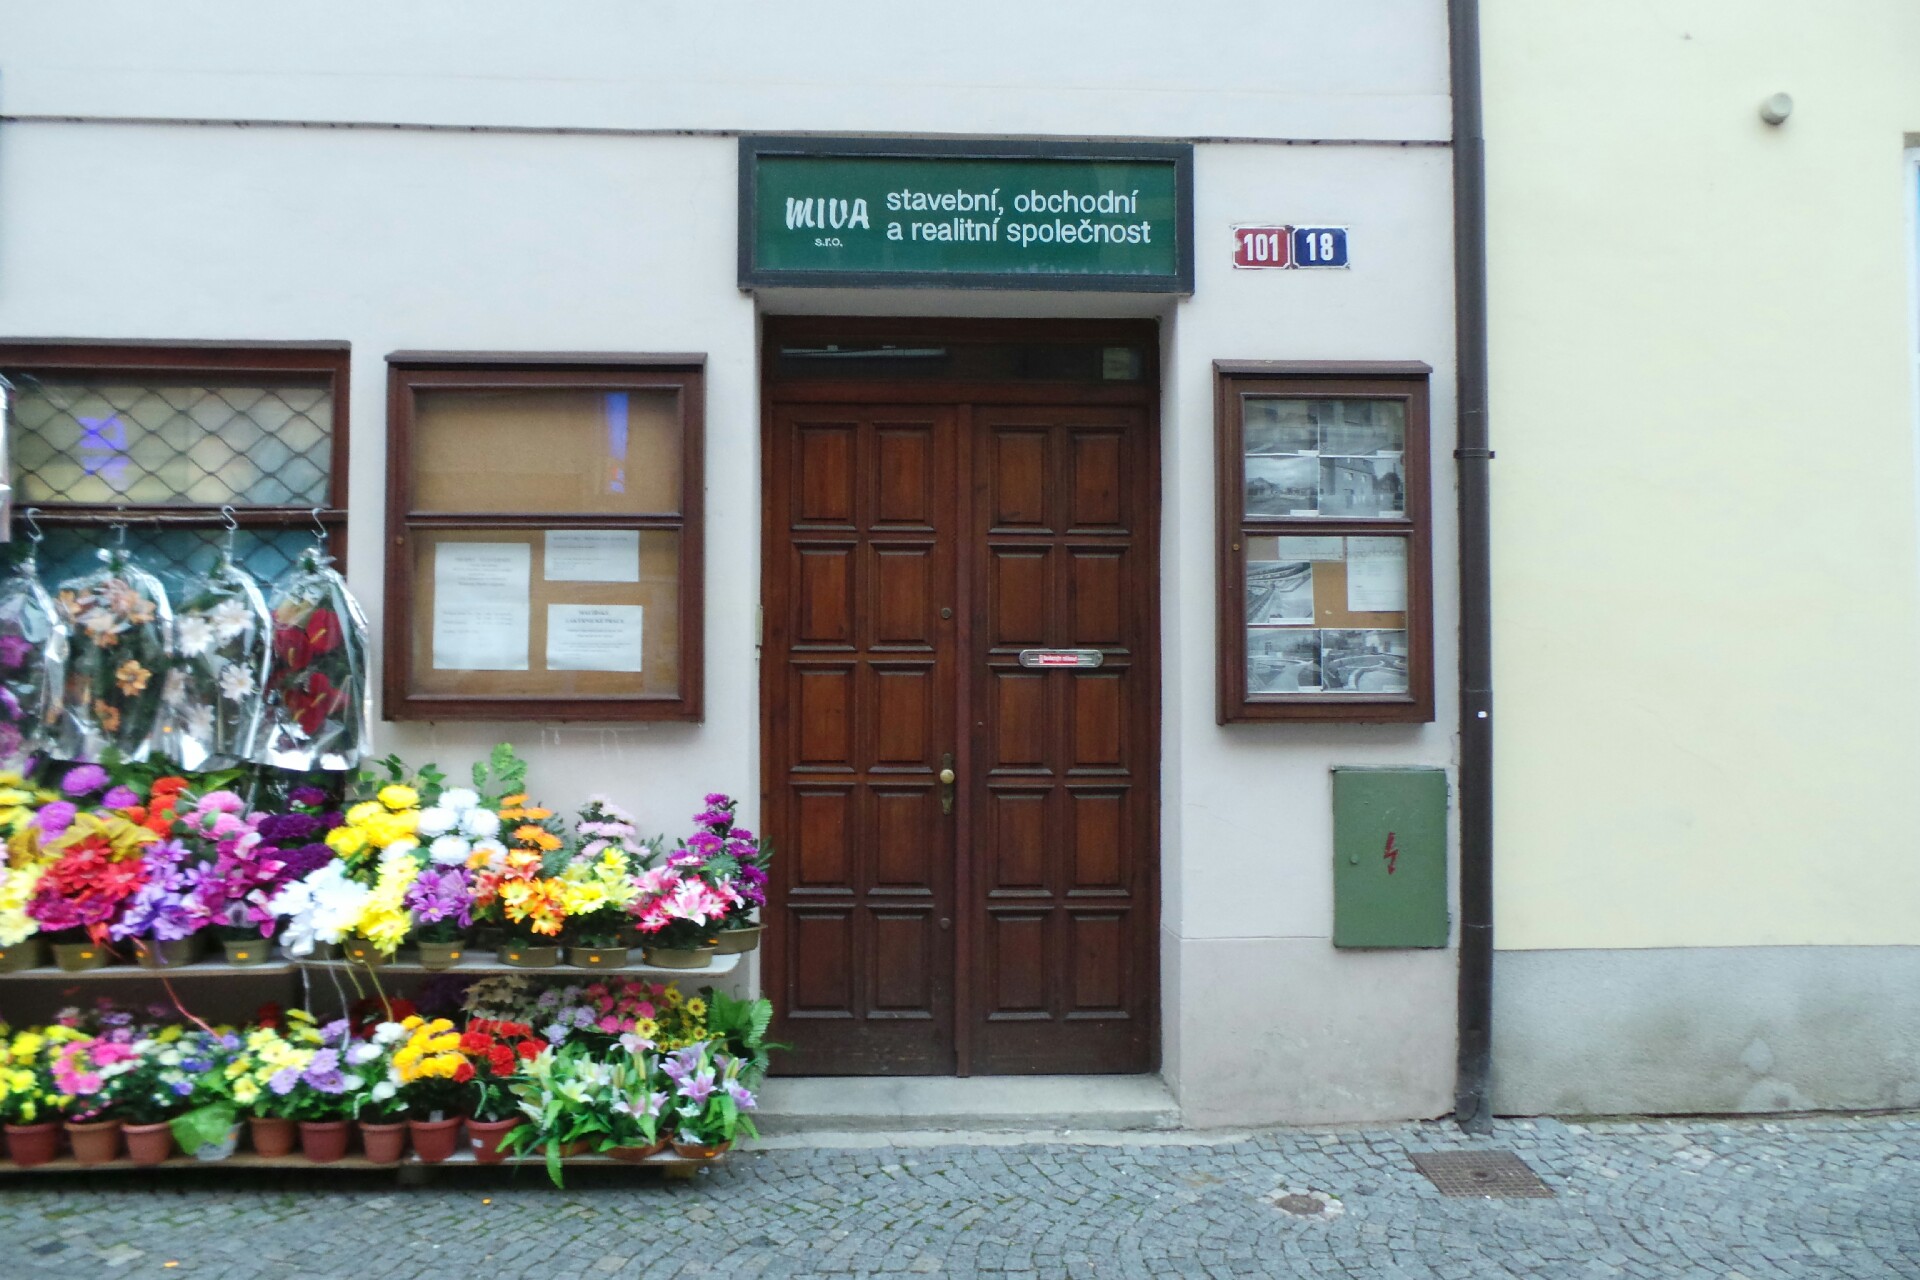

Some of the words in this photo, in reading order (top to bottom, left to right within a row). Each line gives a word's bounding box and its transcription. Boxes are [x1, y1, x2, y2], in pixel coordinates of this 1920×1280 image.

[886, 188, 1005, 216] stavební,
[1014, 189, 1139, 214] obchodní
[814, 237, 844, 247] s.r.o.
[886, 221, 904, 241] a
[911, 217, 1001, 242] realitní
[1006, 218, 1152, 248] společnost
[1244, 233, 1278, 261] 101
[1306, 233, 1334, 261] 18
